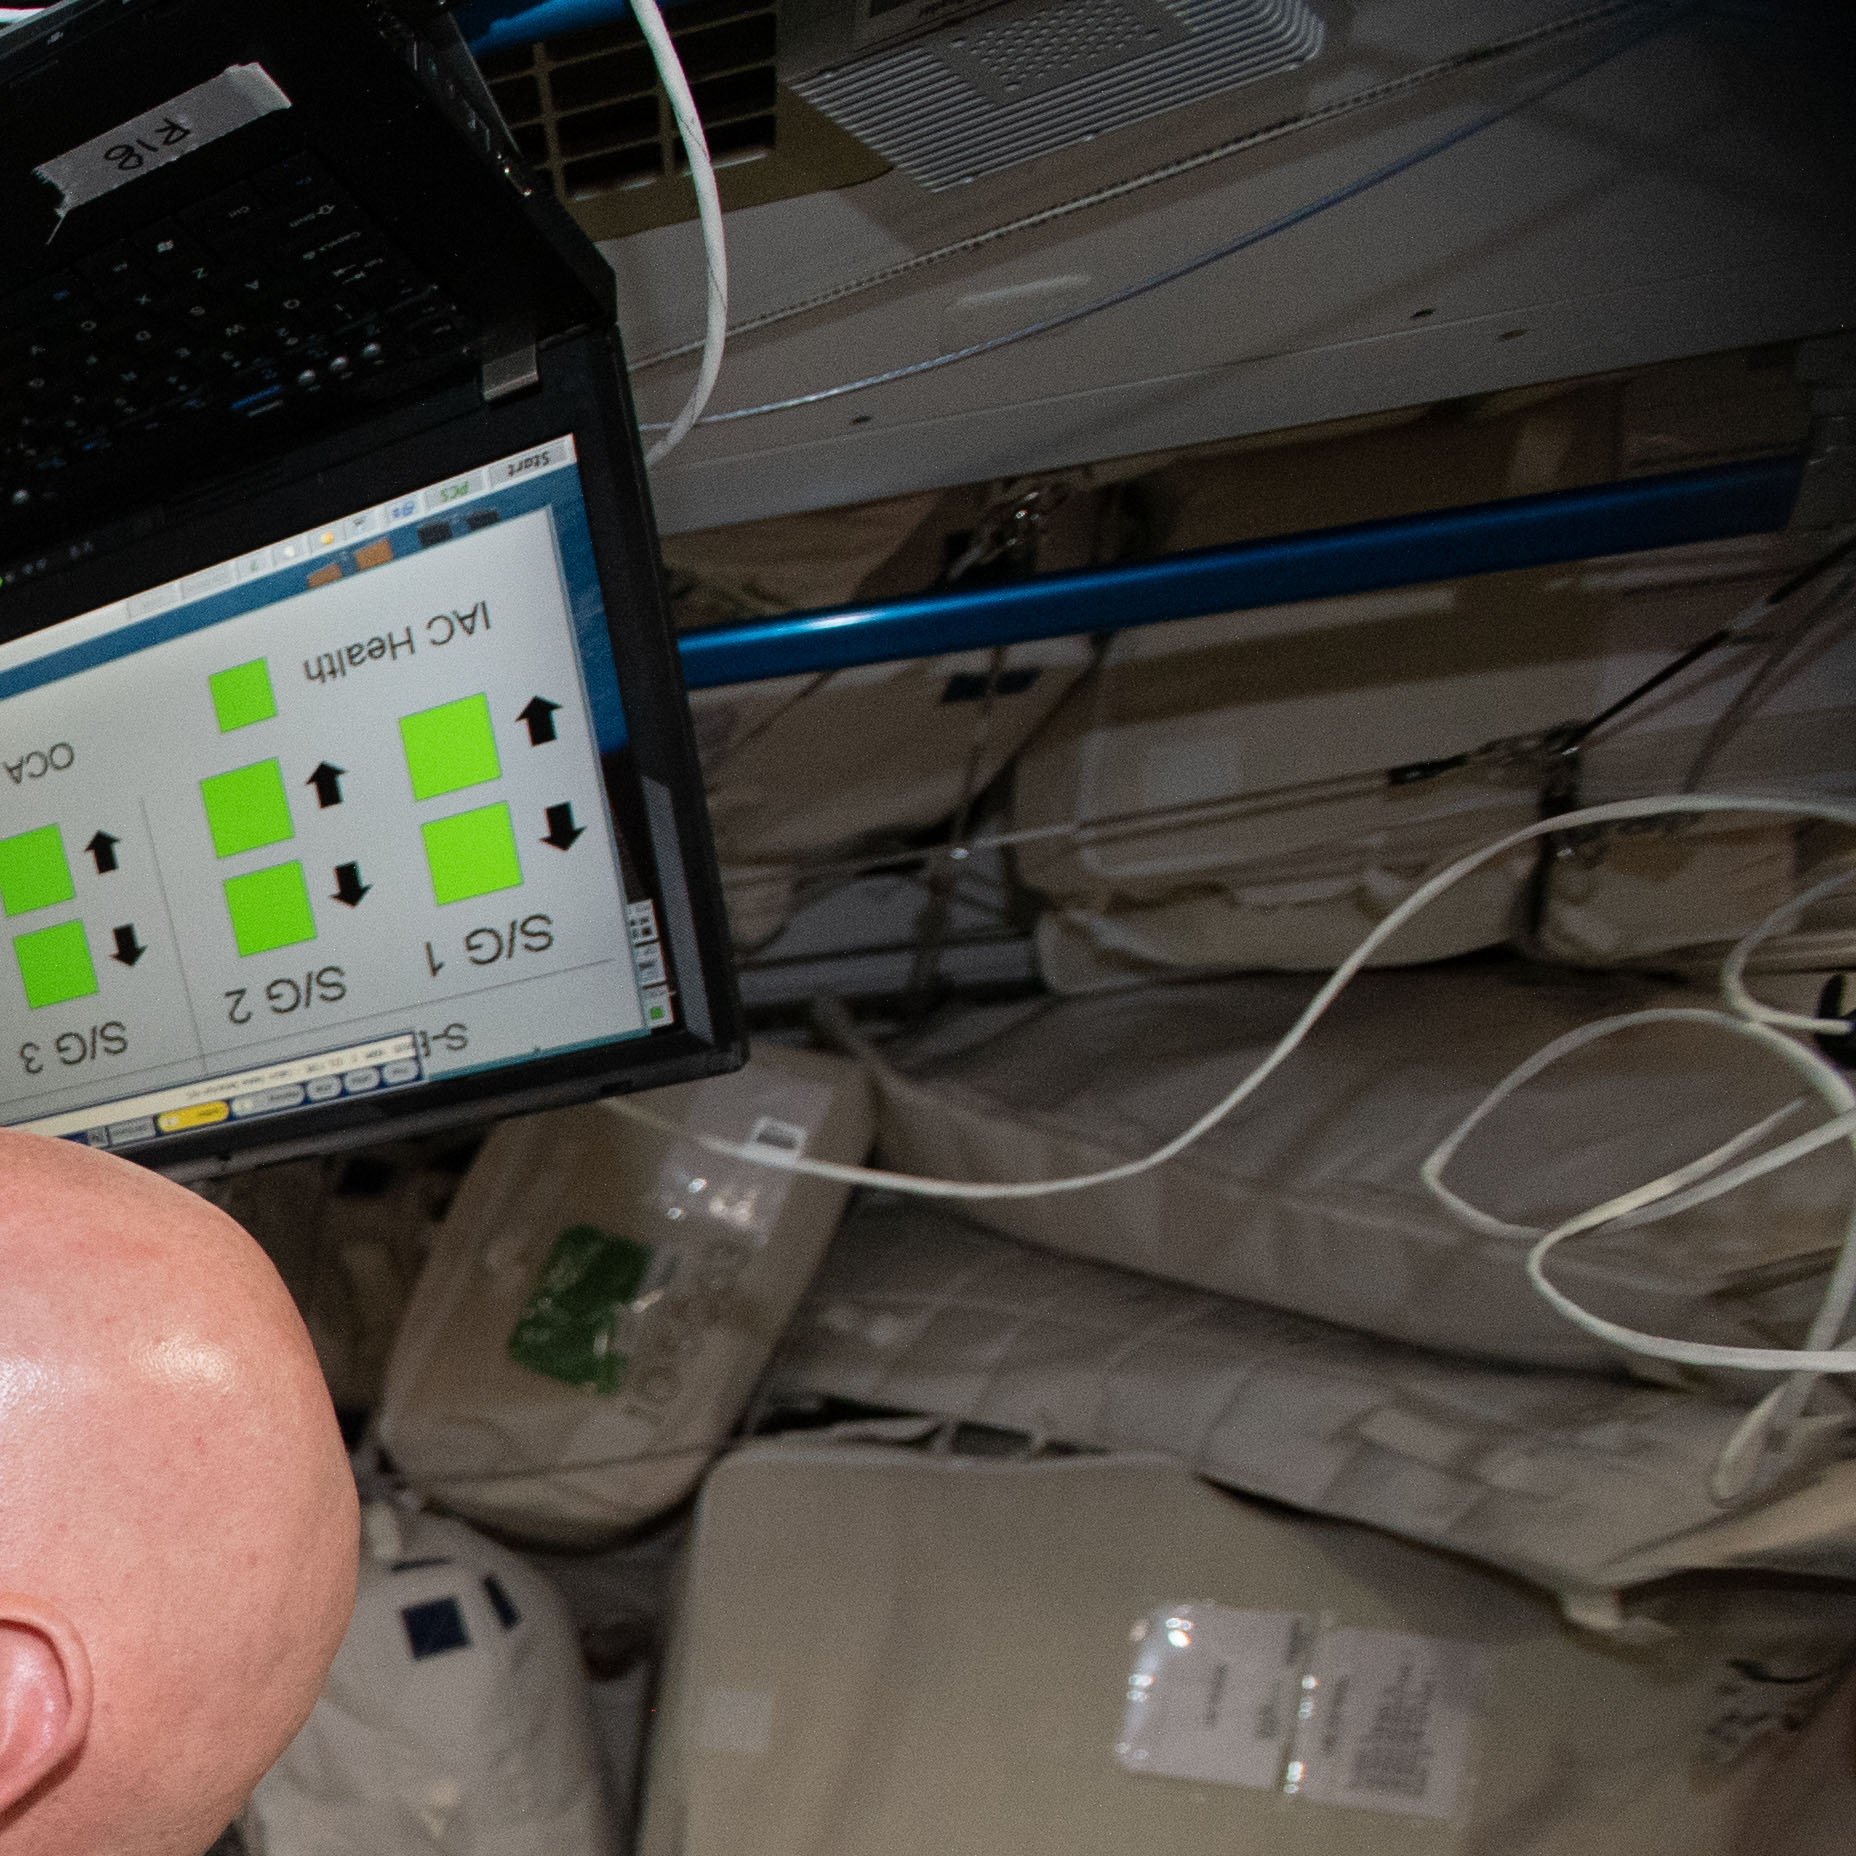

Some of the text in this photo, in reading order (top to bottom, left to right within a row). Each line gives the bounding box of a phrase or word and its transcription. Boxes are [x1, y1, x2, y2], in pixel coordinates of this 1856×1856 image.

[103, 117, 191, 172] R18
[507, 451, 550, 477] Start
[302, 600, 491, 683] IAC Health
[2, 741, 76, 785] OCA
[423, 913, 556, 978] S/G 1
[222, 965, 349, 1026] S/G 2
[18, 1020, 129, 1076] S/G 3
